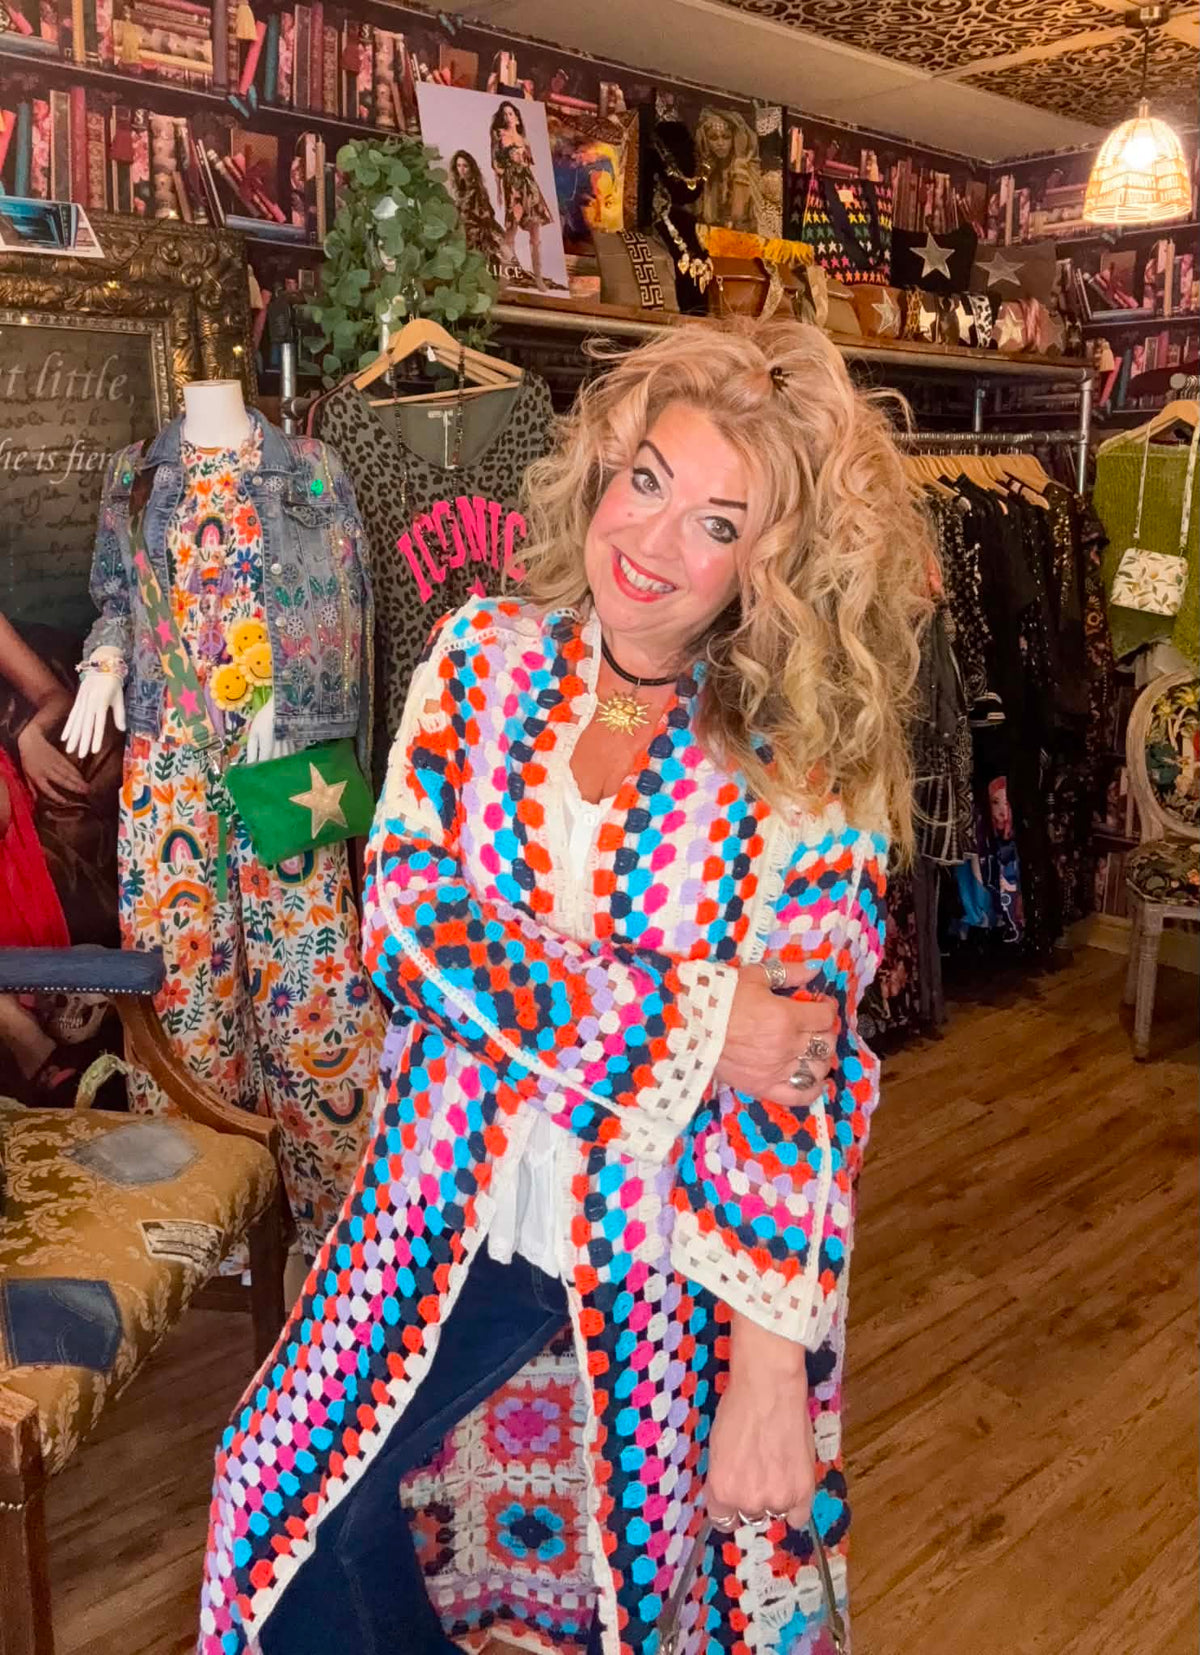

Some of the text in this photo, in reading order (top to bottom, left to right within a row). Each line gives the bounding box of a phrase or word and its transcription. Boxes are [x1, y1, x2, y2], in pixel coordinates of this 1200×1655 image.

[35, 351, 135, 408] little,
[36, 445, 58, 471] is
[49, 439, 113, 485] fier
[396, 495, 527, 604] ICONIC
